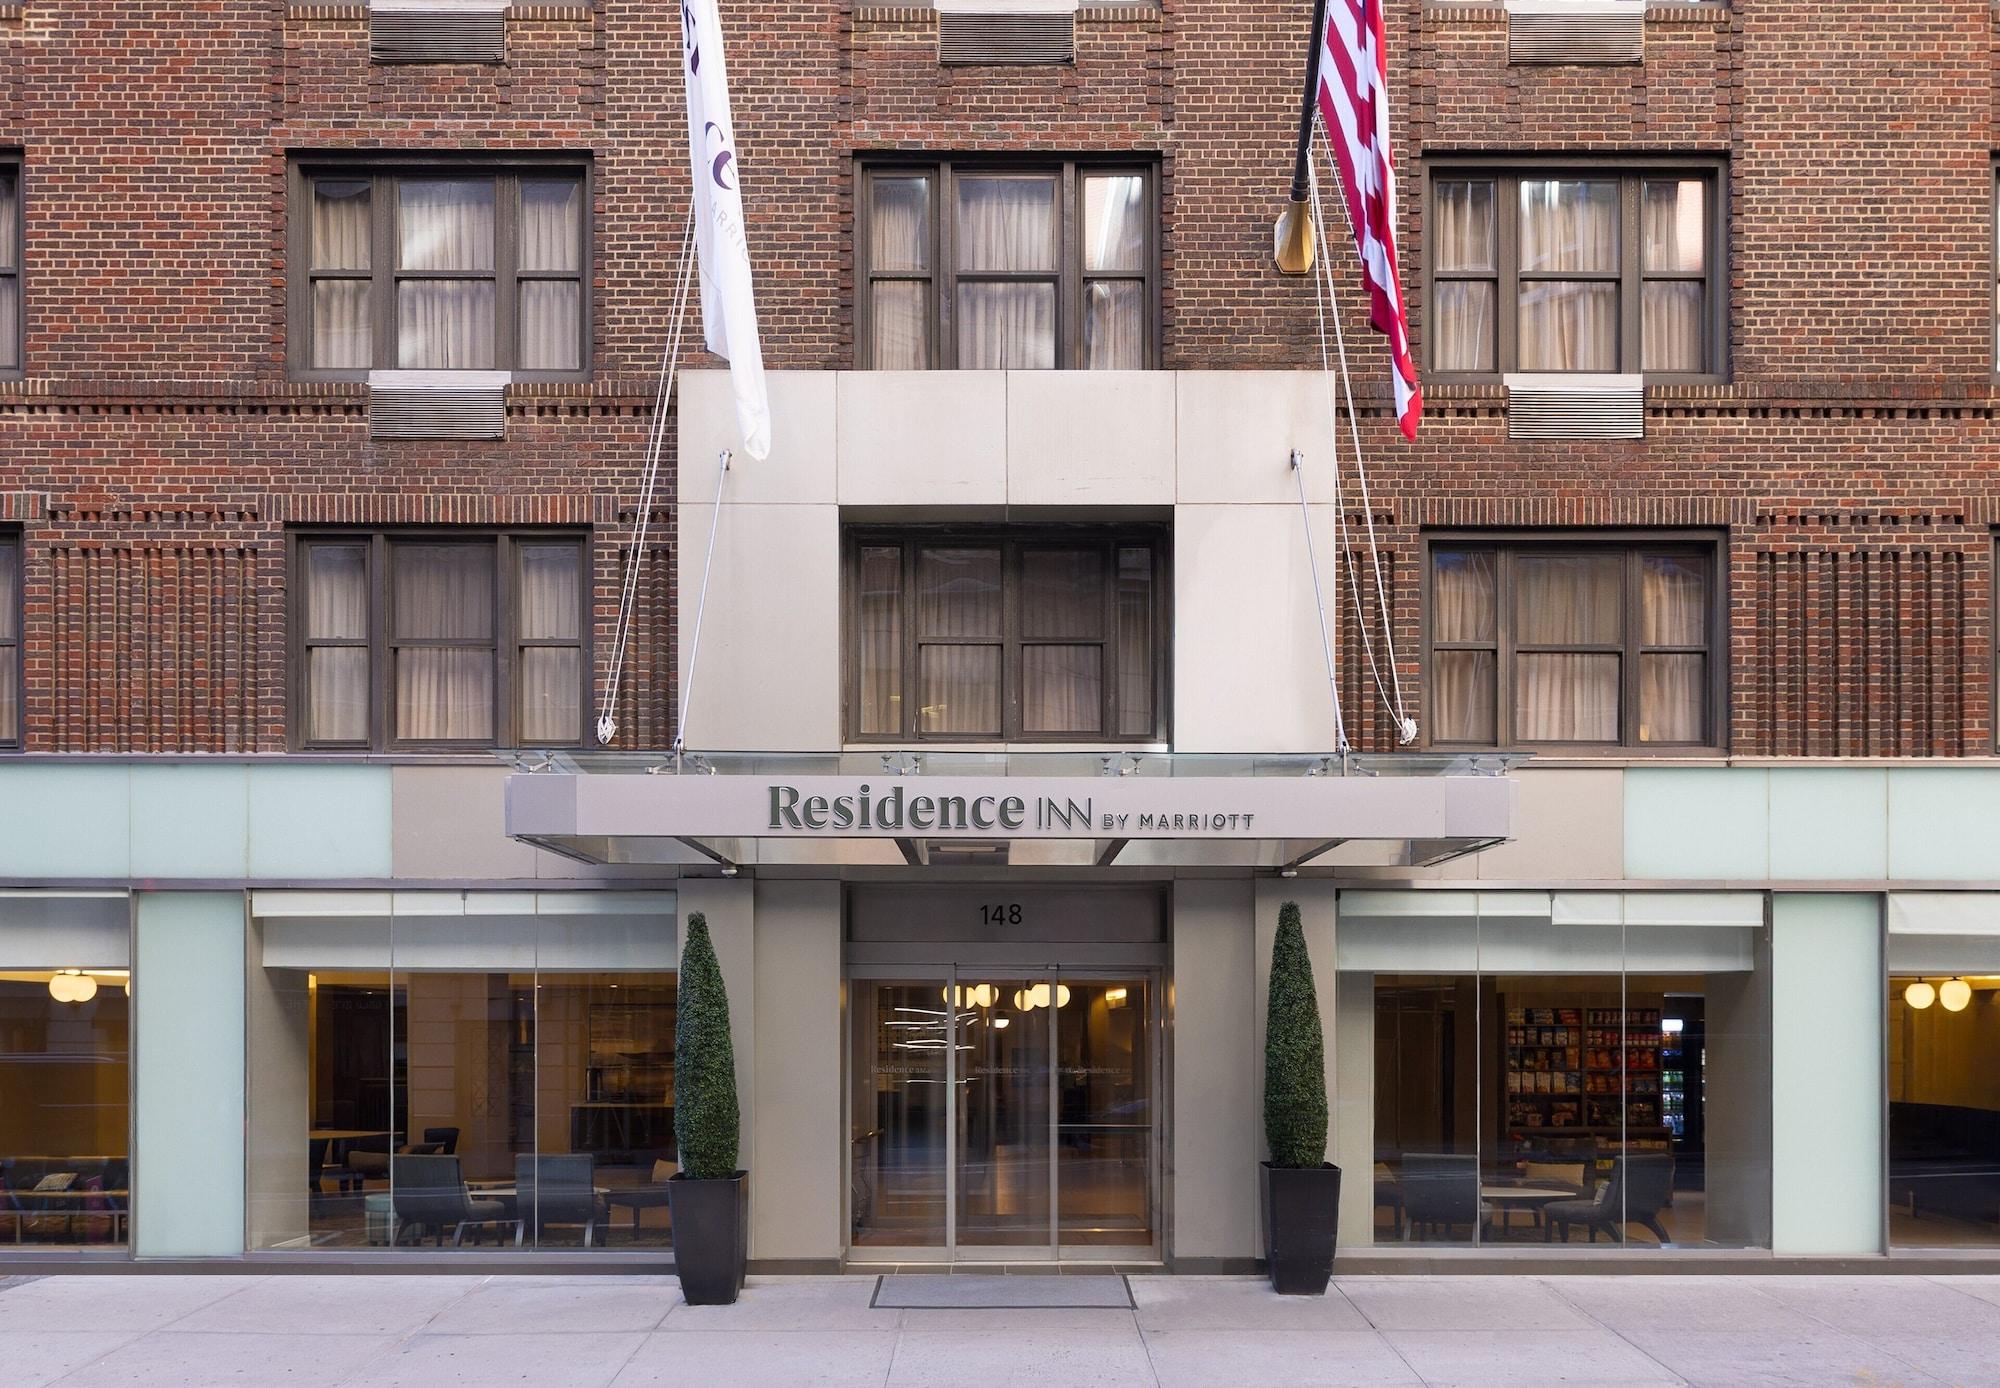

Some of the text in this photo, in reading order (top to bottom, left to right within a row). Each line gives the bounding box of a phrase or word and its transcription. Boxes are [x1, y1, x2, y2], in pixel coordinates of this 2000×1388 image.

[768, 784, 1255, 830] Residence INN BY MARRIOTT
[980, 903, 1022, 925] 148
